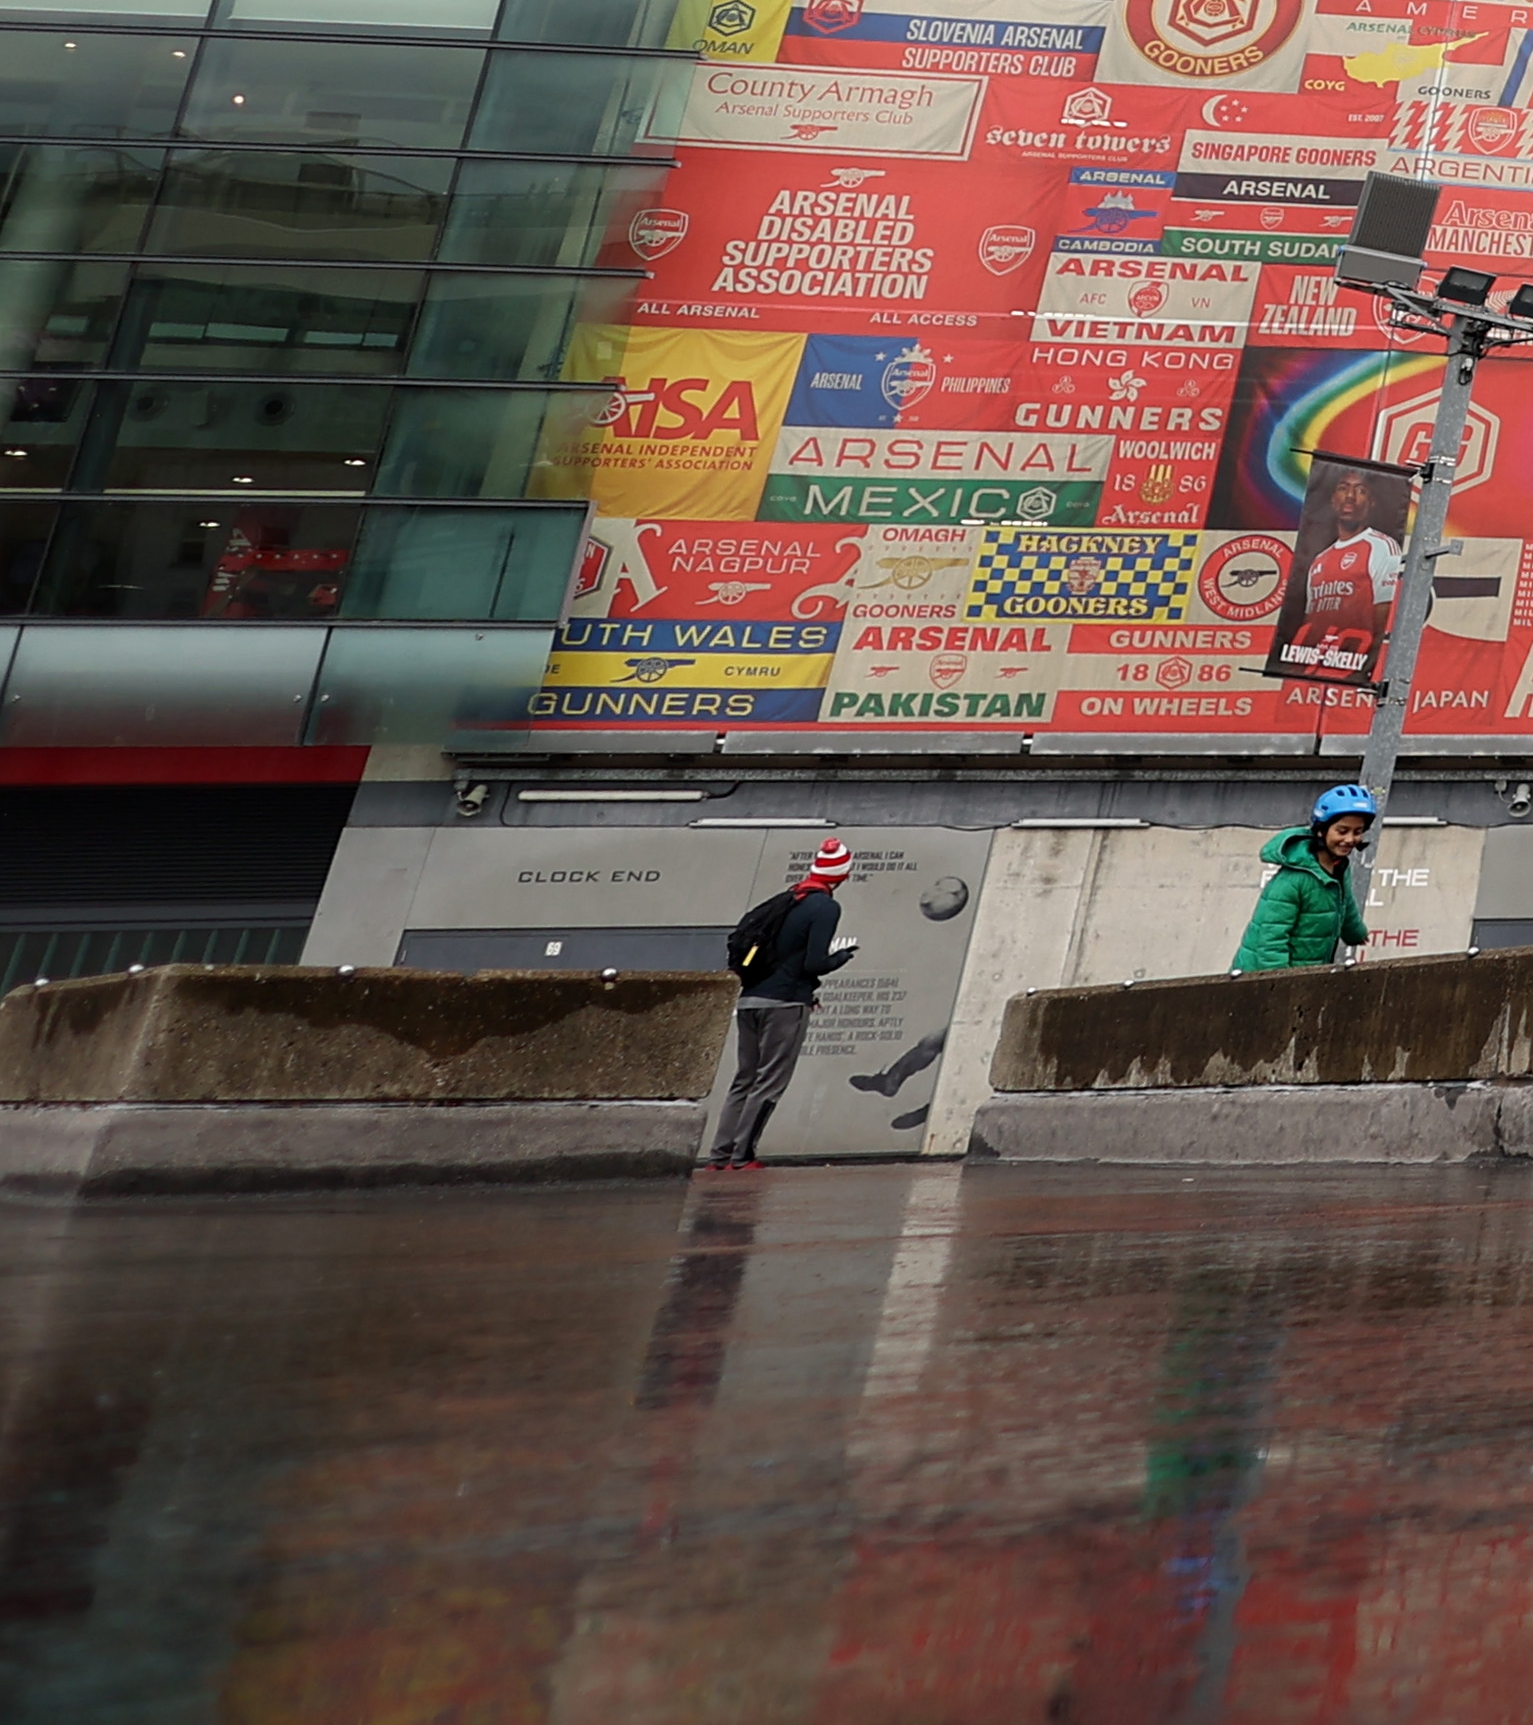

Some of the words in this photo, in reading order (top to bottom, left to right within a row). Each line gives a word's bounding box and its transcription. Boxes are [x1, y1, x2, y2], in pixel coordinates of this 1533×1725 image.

[906, 19, 995, 46] SLOVENIA
[1000, 23, 1084, 51] ARSENAL
[901, 47, 1023, 75] SUPPORTERS
[1028, 52, 1076, 78] CLUB
[706, 73, 816, 102] County
[819, 80, 934, 109] Armagh
[715, 101, 779, 118] Arsenal
[783, 103, 871, 125] Supporters
[875, 108, 913, 125] Club
[1190, 141, 1292, 166] SINGAPORE
[1293, 145, 1377, 168] GOONERS
[758, 216, 914, 245] DISABLED
[722, 241, 934, 273] SUPPORTERS
[712, 267, 927, 300] ASSOCIATION
[1288, 276, 1335, 305] NEW
[637, 301, 672, 317] ALL
[678, 303, 760, 320] ARSENAL
[870, 311, 900, 325] ALL
[905, 312, 977, 328] ACCESS
[1258, 303, 1356, 334] ZEALAND
[1047, 319, 1237, 343] VIETNAM
[1031, 347, 1128, 367] HONG
[1141, 350, 1233, 370] KONG
[1118, 440, 1217, 460] WOOLWICH
[882, 527, 966, 543] OMAGH
[671, 556, 809, 576] NAGPUR
[675, 623, 827, 647] WALES
[852, 627, 1051, 651] ARSENAL
[1280, 644, 1368, 670] LEWIS-SKELLY
[829, 692, 1047, 717] PAKISTAN
[1081, 697, 1136, 717] ON
[1146, 697, 1253, 716] WHEELS
[1413, 689, 1489, 712] JAPAN
[517, 871, 599, 883] CLOCK
[612, 871, 660, 882] END
[1378, 869, 1430, 886] THE
[1369, 930, 1419, 946] THE
